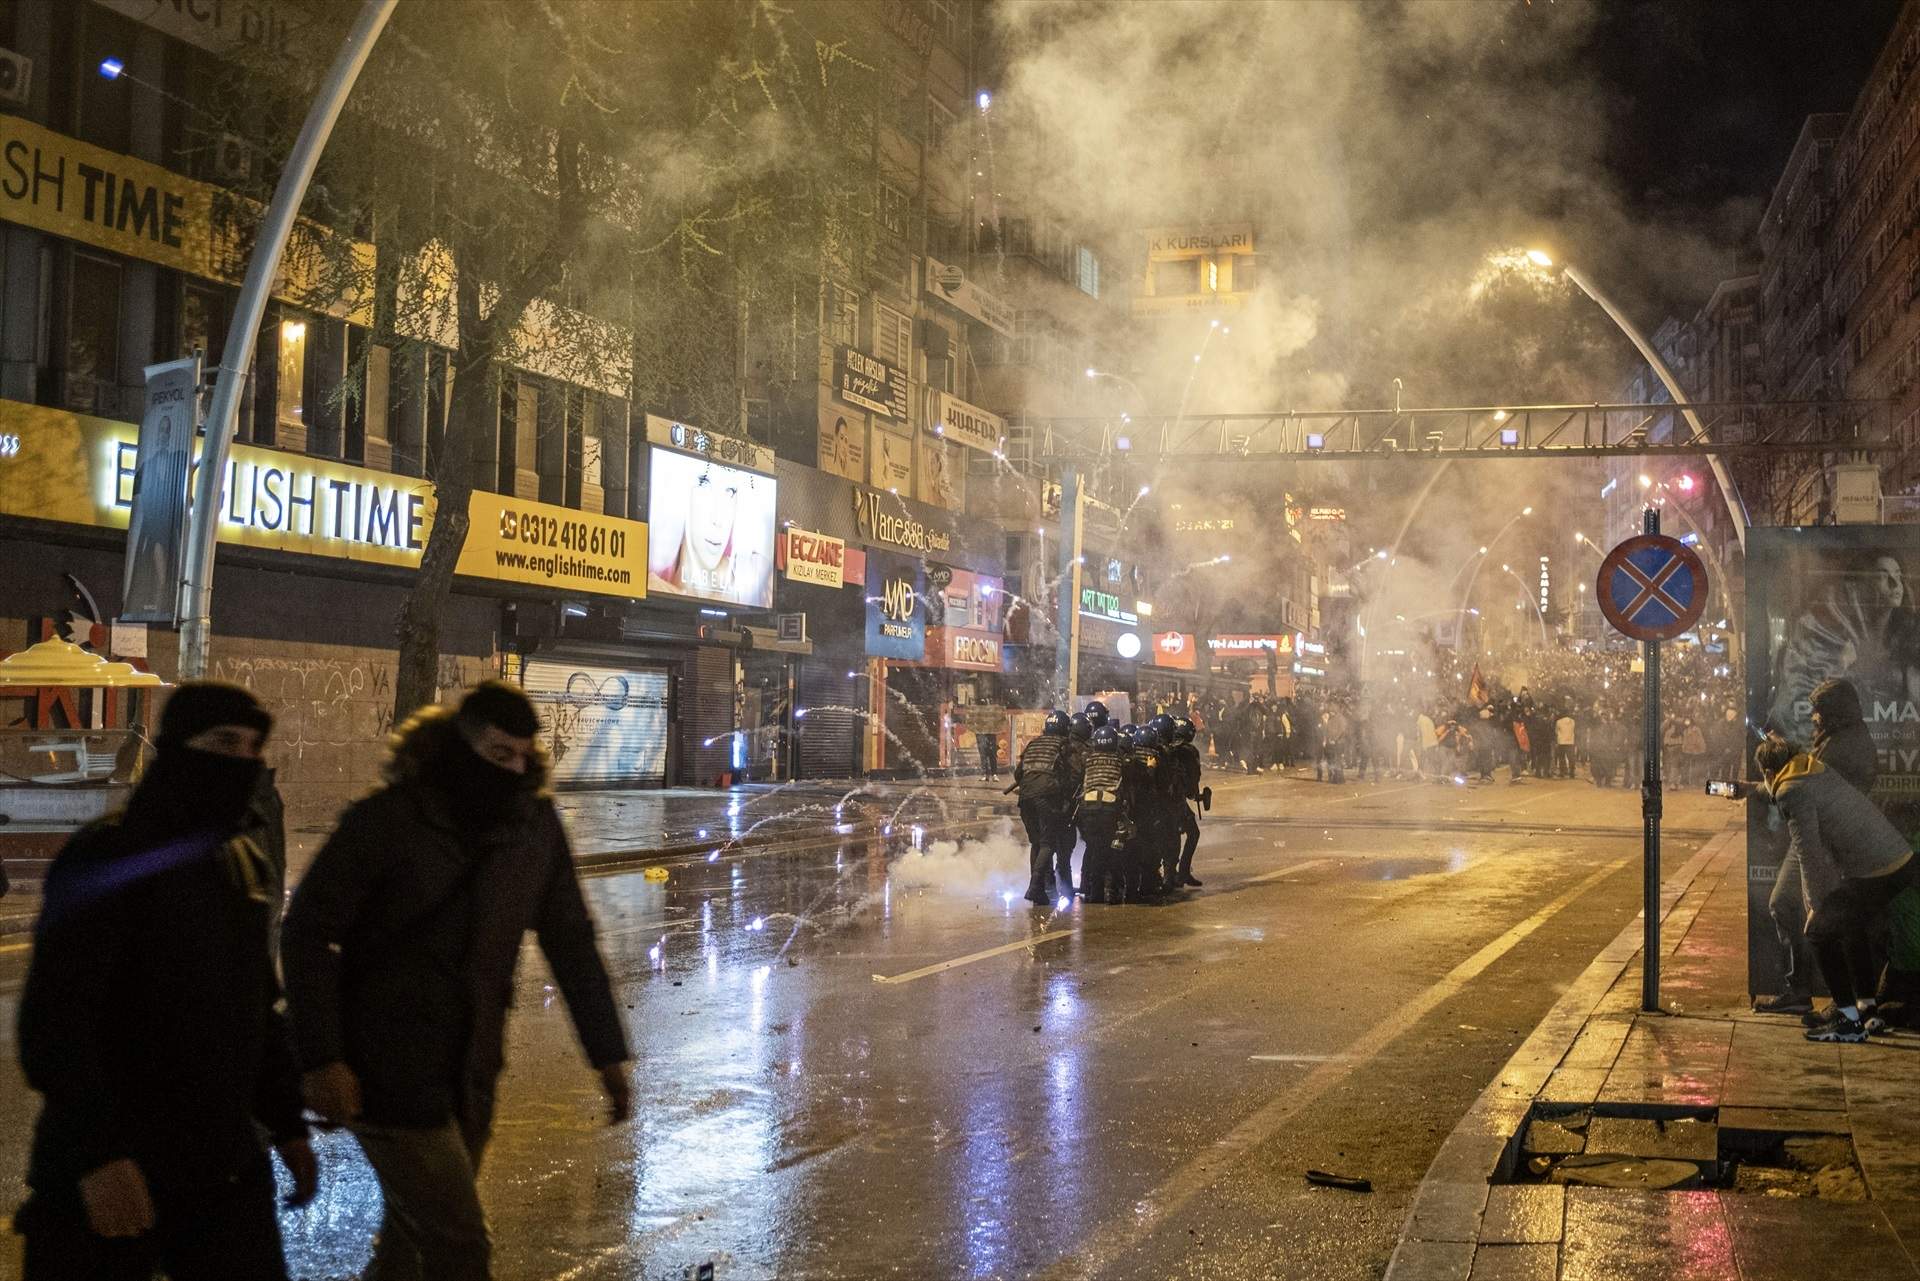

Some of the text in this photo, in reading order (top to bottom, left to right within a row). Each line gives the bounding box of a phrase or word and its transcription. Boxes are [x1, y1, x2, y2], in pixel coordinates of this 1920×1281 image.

[2, 140, 65, 212] SH
[78, 162, 185, 249] TIME
[1167, 233, 1247, 250] KURSLARI
[326, 478, 425, 551] TIME
[867, 492, 924, 550] Vanessa
[520, 513, 626, 558] 0312 418 61 01
[790, 533, 843, 568] ECZANE
[496, 551, 631, 584] www.englishtime.com
[816, 568, 838, 583] MERKEZ
[883, 577, 914, 622] MAD
[1081, 588, 1096, 613] ART
[1097, 591, 1119, 615] TATTOO
